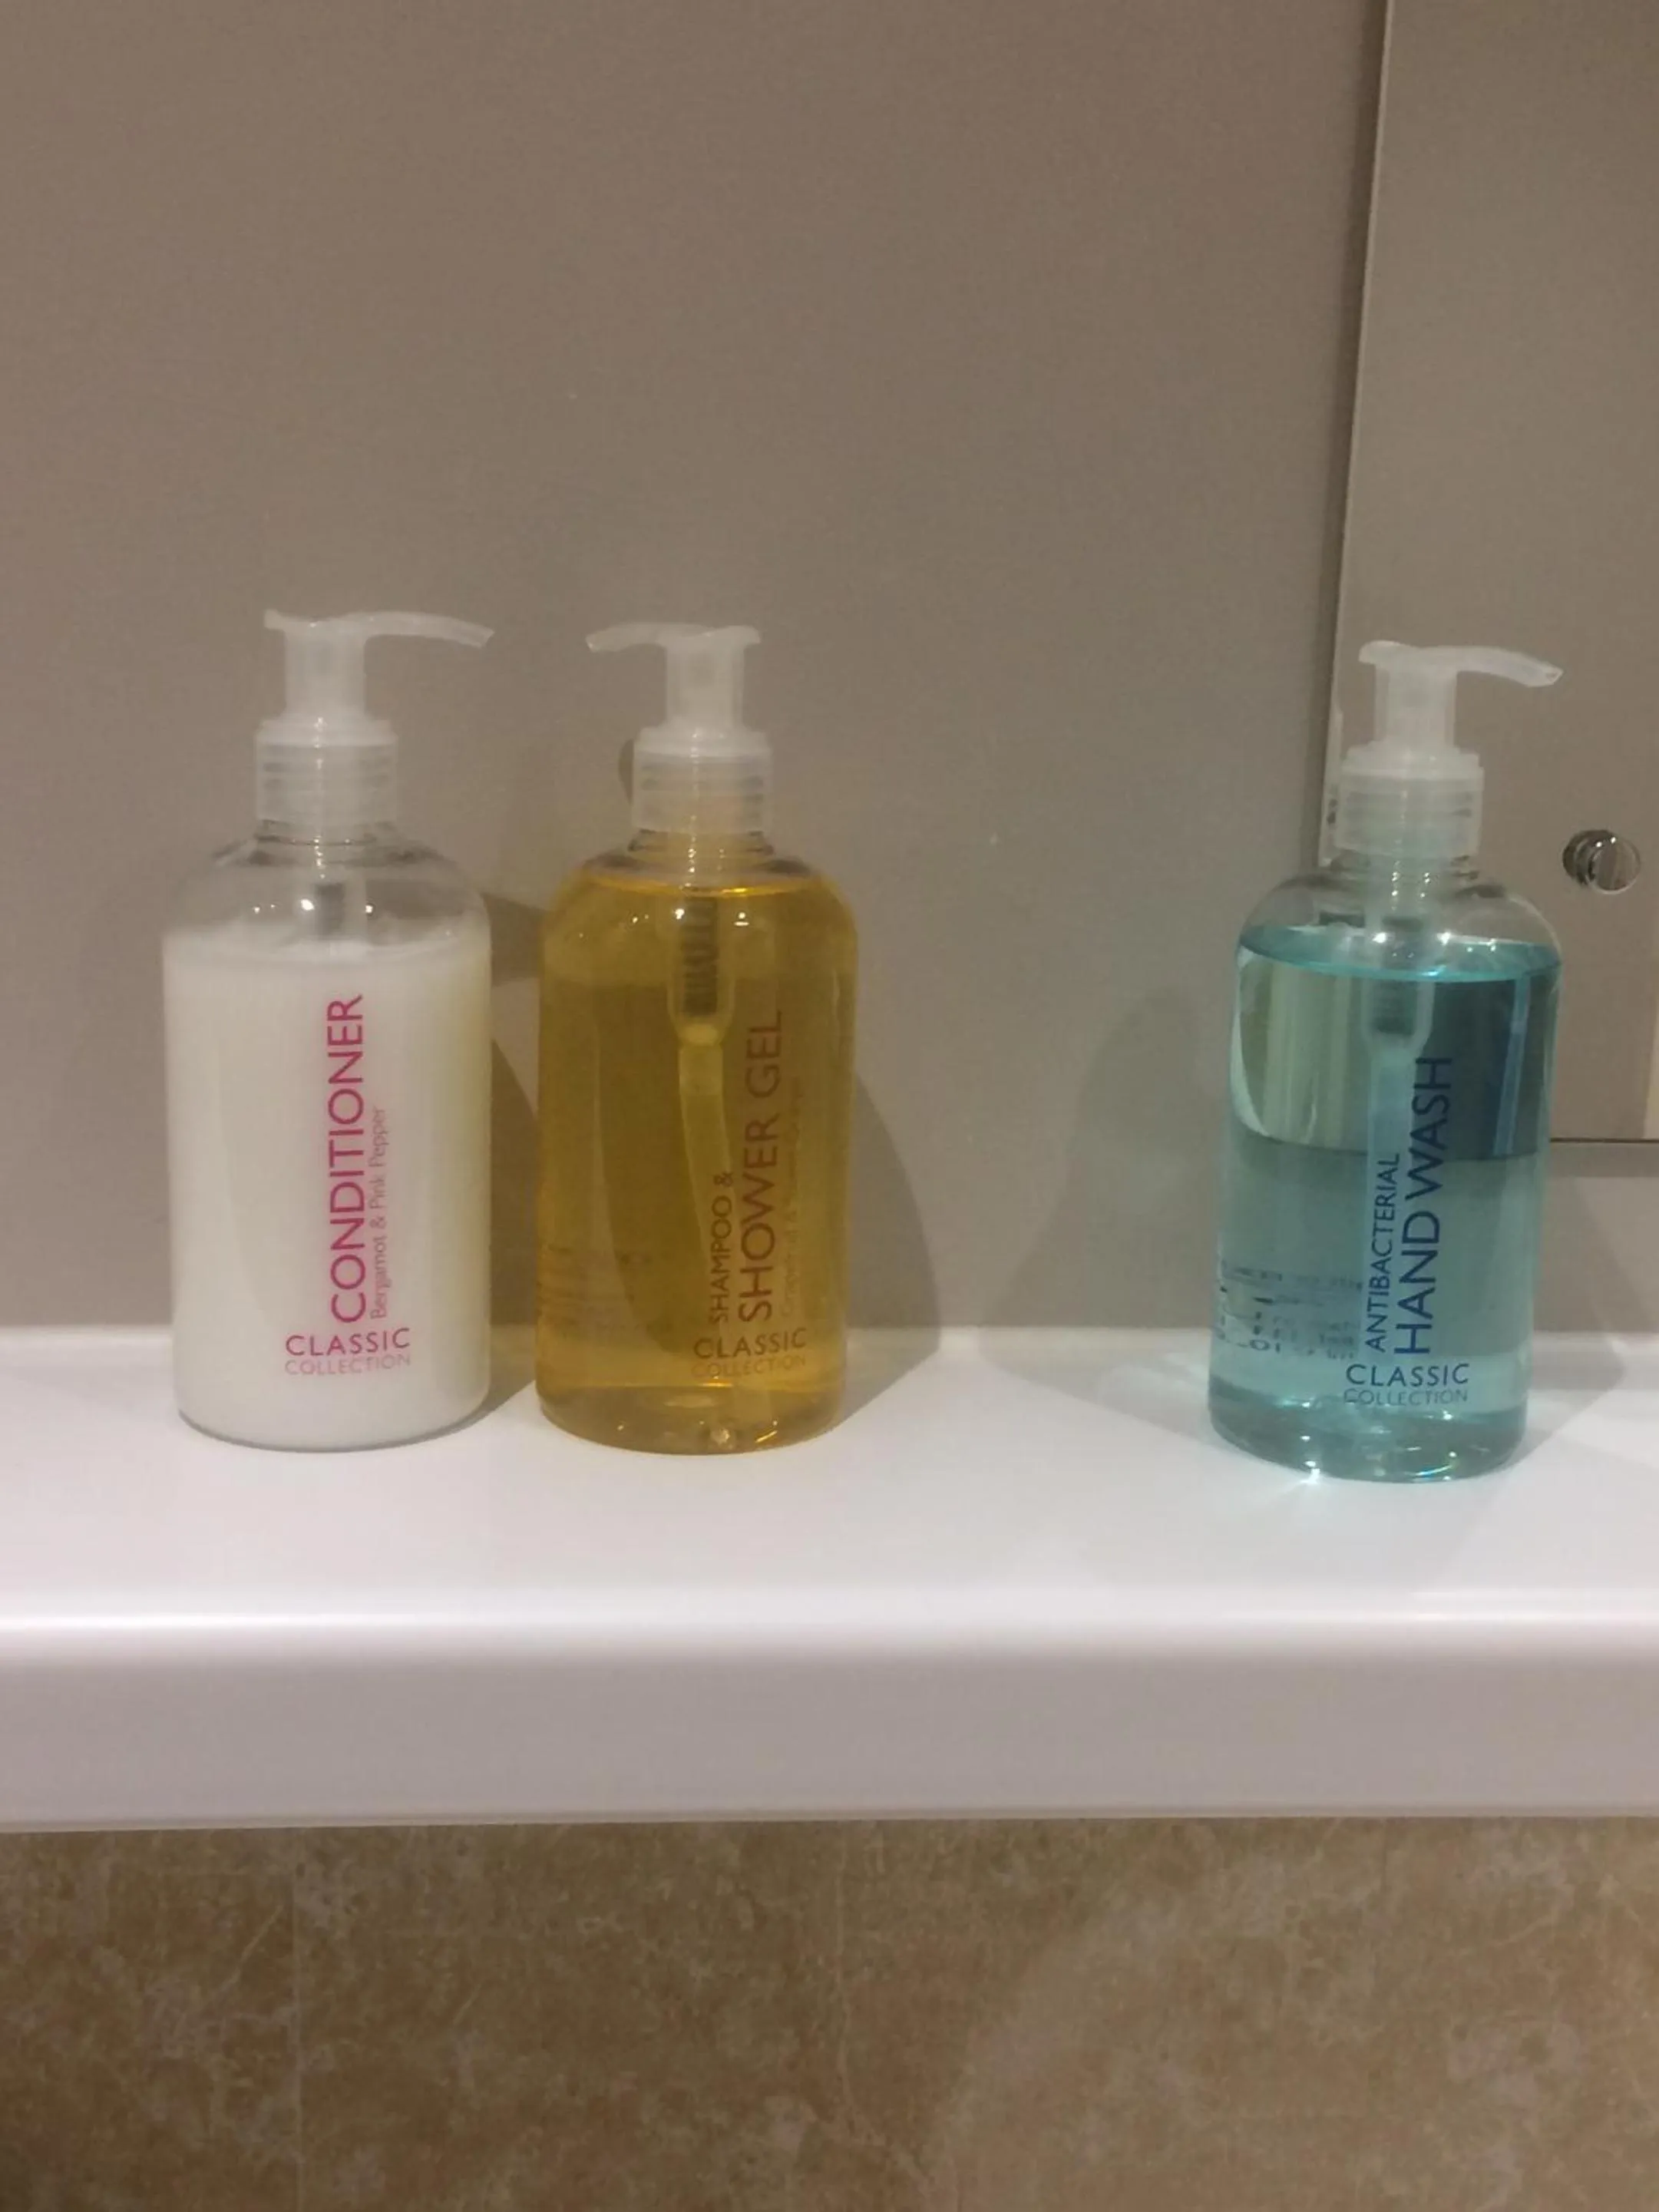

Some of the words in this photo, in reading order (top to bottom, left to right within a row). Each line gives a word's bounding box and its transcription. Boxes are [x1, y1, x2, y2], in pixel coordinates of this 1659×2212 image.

[745, 1010, 782, 1099] GEL
[368, 1106, 390, 1168] Pepper
[1405, 1057, 1453, 1202] WASH
[326, 994, 366, 1323] CONDITIONER
[713, 1172, 734, 1188] &
[368, 1175, 386, 1209] Pink
[369, 1215, 386, 1230] &
[739, 1113, 780, 1322] SHOWER
[709, 1195, 734, 1324] SHAMPOO
[1365, 1153, 1400, 1352] ANTIBACTERIAL
[369, 1236, 392, 1319] Bergamot
[1394, 1211, 1440, 1354] HAND
[285, 1328, 411, 1357] CLASSIC
[285, 1354, 411, 1377] COLLECTION
[692, 1354, 806, 1379] COLLECTION
[693, 1328, 807, 1360] CLASSIC
[1343, 1387, 1469, 1407] COLLECTION
[1346, 1363, 1470, 1387] CLASSIC
